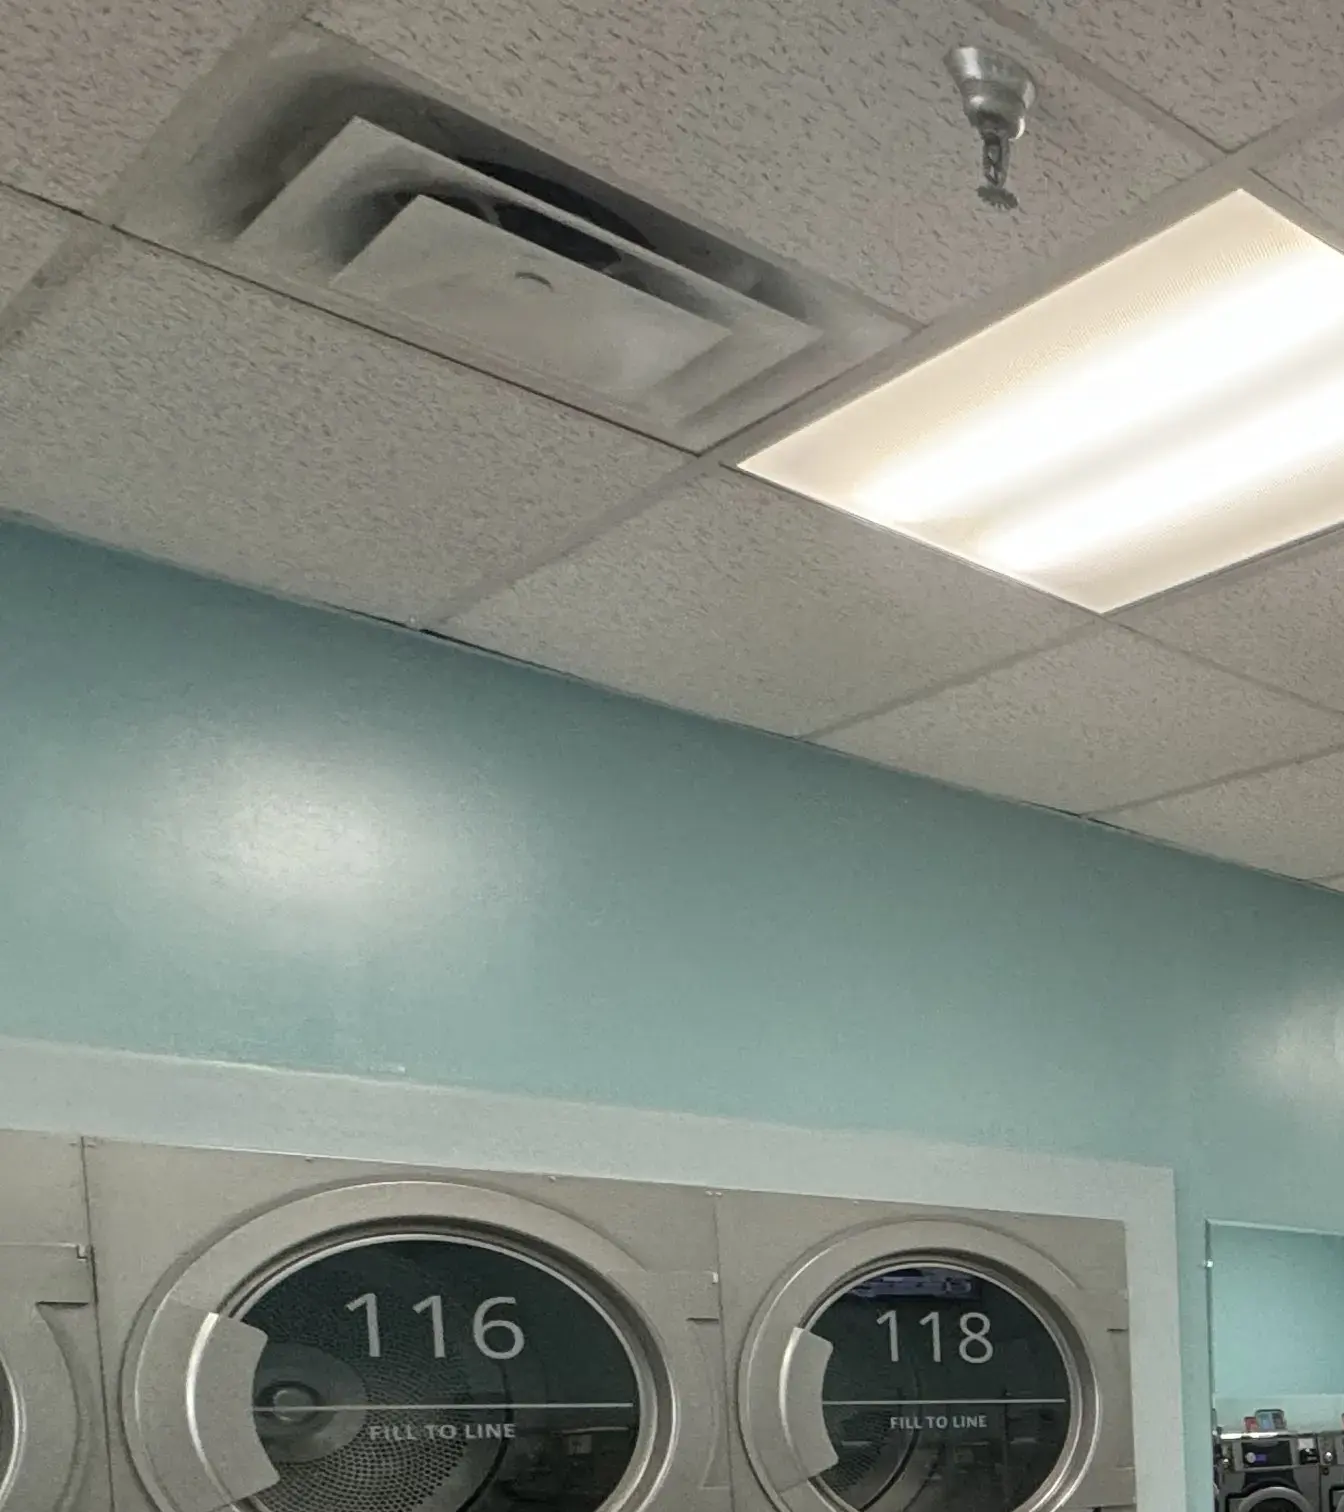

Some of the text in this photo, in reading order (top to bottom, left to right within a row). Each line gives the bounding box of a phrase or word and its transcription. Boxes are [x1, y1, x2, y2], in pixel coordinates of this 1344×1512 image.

[345, 1292, 526, 1361] 116
[876, 1309, 994, 1364] 118
[369, 1423, 517, 1440] FILL TO LINE
[890, 1415, 988, 1430] FILL TO LINE
